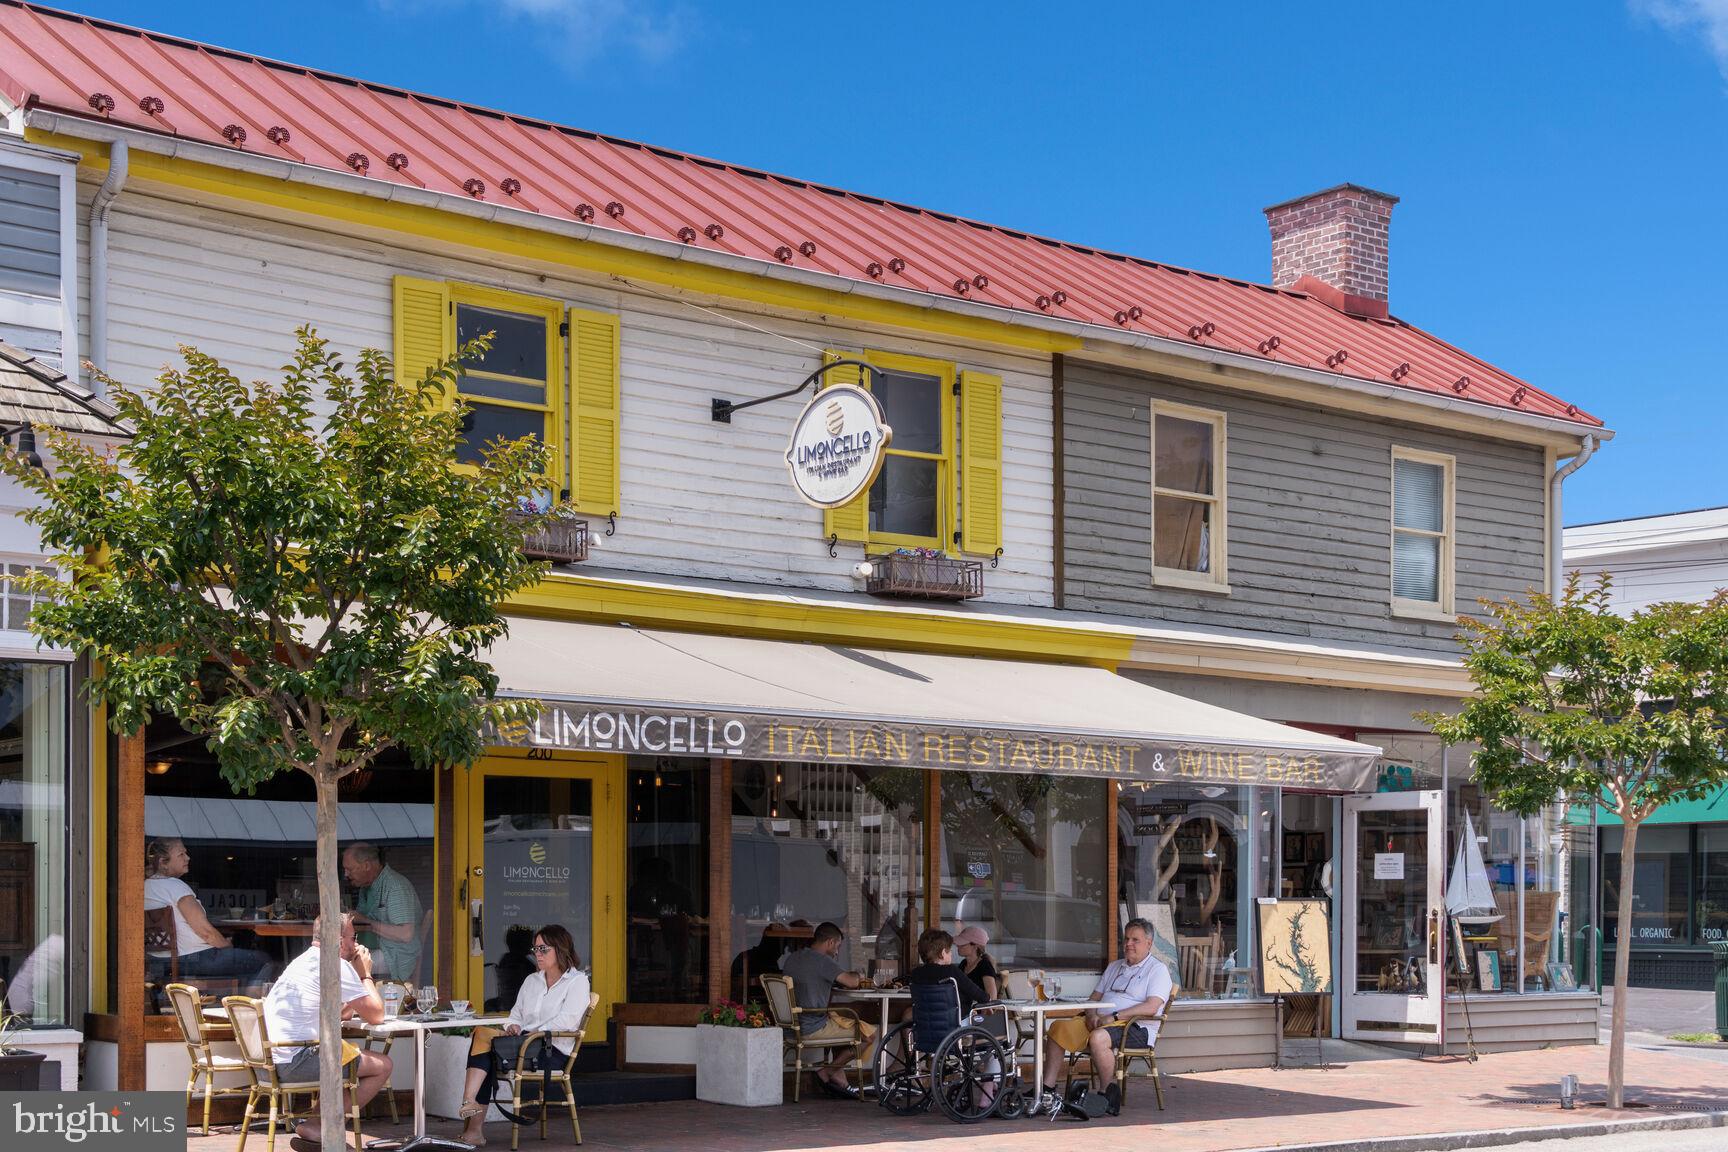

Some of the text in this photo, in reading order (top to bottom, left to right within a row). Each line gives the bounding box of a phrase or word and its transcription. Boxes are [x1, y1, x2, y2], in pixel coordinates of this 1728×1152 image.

[798, 430, 871, 464] LIMONCELLO
[528, 748, 553, 761] 200
[533, 708, 1322, 784] LIMONCELLO ITALIAN RESTAURANT & WINE BAR
[503, 866, 570, 879] LIMONCELLO
